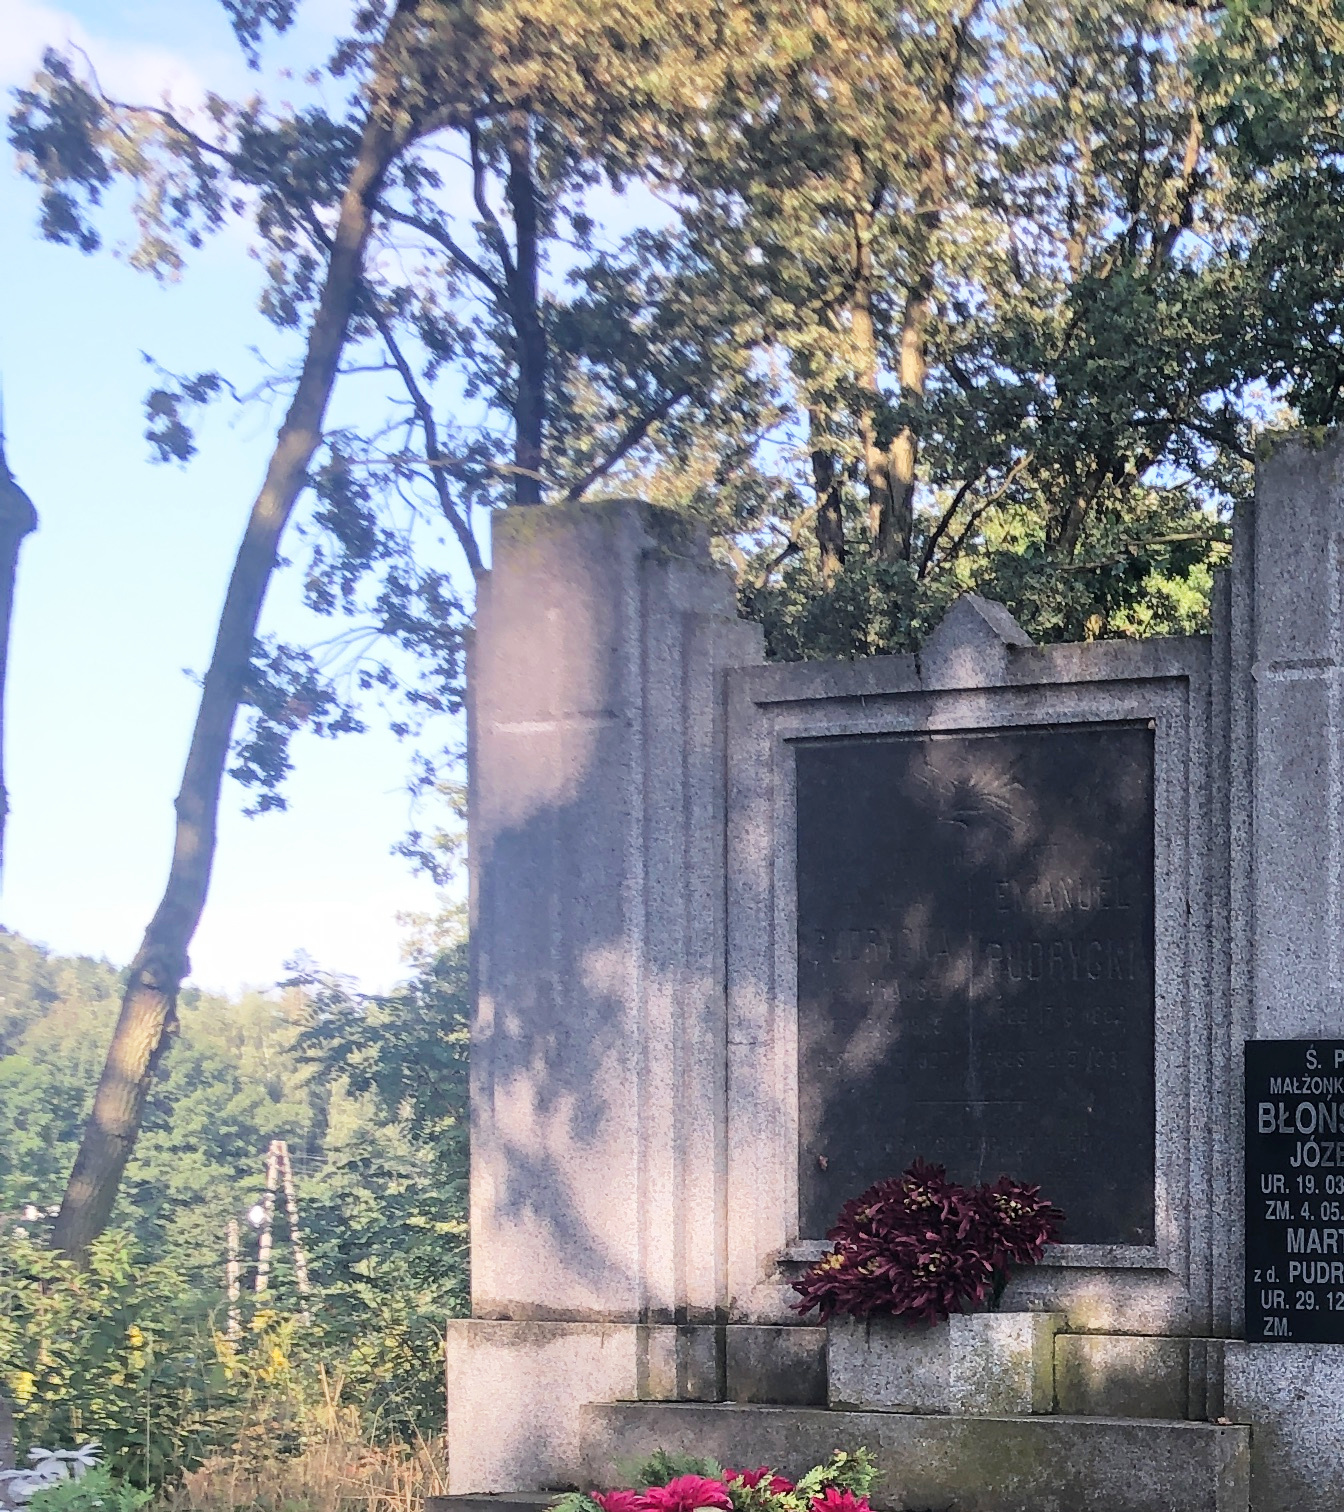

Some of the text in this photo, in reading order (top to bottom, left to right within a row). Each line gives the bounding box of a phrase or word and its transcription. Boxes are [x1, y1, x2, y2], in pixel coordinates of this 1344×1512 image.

[1261, 1174, 1289, 1195] UR.
[1296, 1175, 1319, 1195] 19.
[1265, 1201, 1294, 1220] ZM.
[1300, 1201, 1315, 1221] 4.
[1320, 1201, 1344, 1221] 05.
[1261, 1290, 1289, 1310] UR.
[1295, 1290, 1319, 1311] 29.
[1263, 1317, 1293, 1337] ZM.
